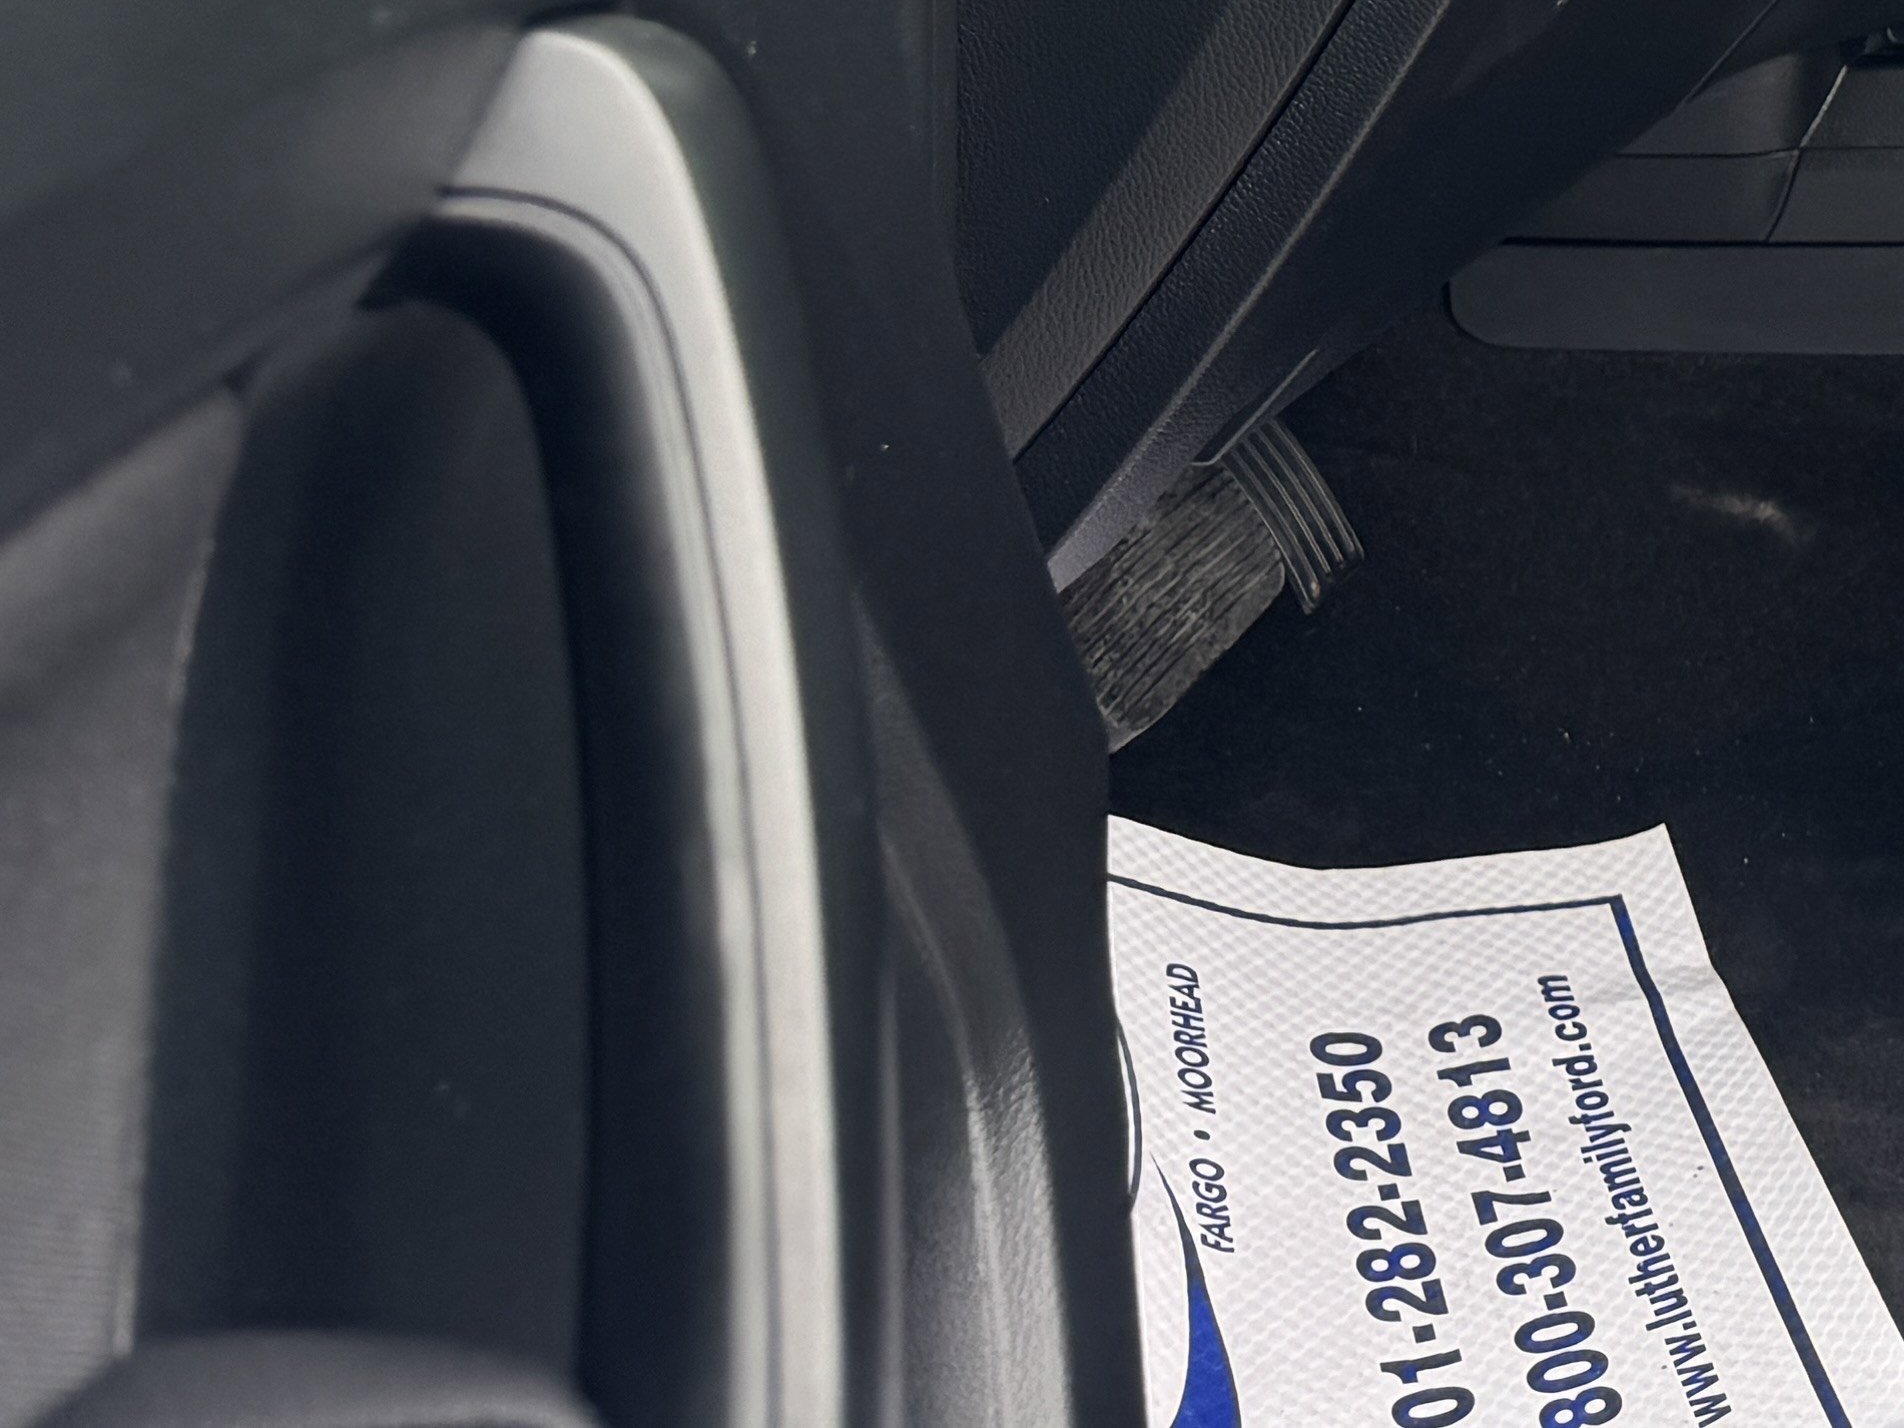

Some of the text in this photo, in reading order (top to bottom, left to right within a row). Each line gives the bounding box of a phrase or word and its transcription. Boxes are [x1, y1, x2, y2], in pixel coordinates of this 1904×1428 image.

[1166, 963, 1235, 1253] FARGO MOORHEAD
[1428, 1014, 1622, 1428] 800-307-4813
[1537, 975, 1731, 1428] www.lutherfamilyford.com
